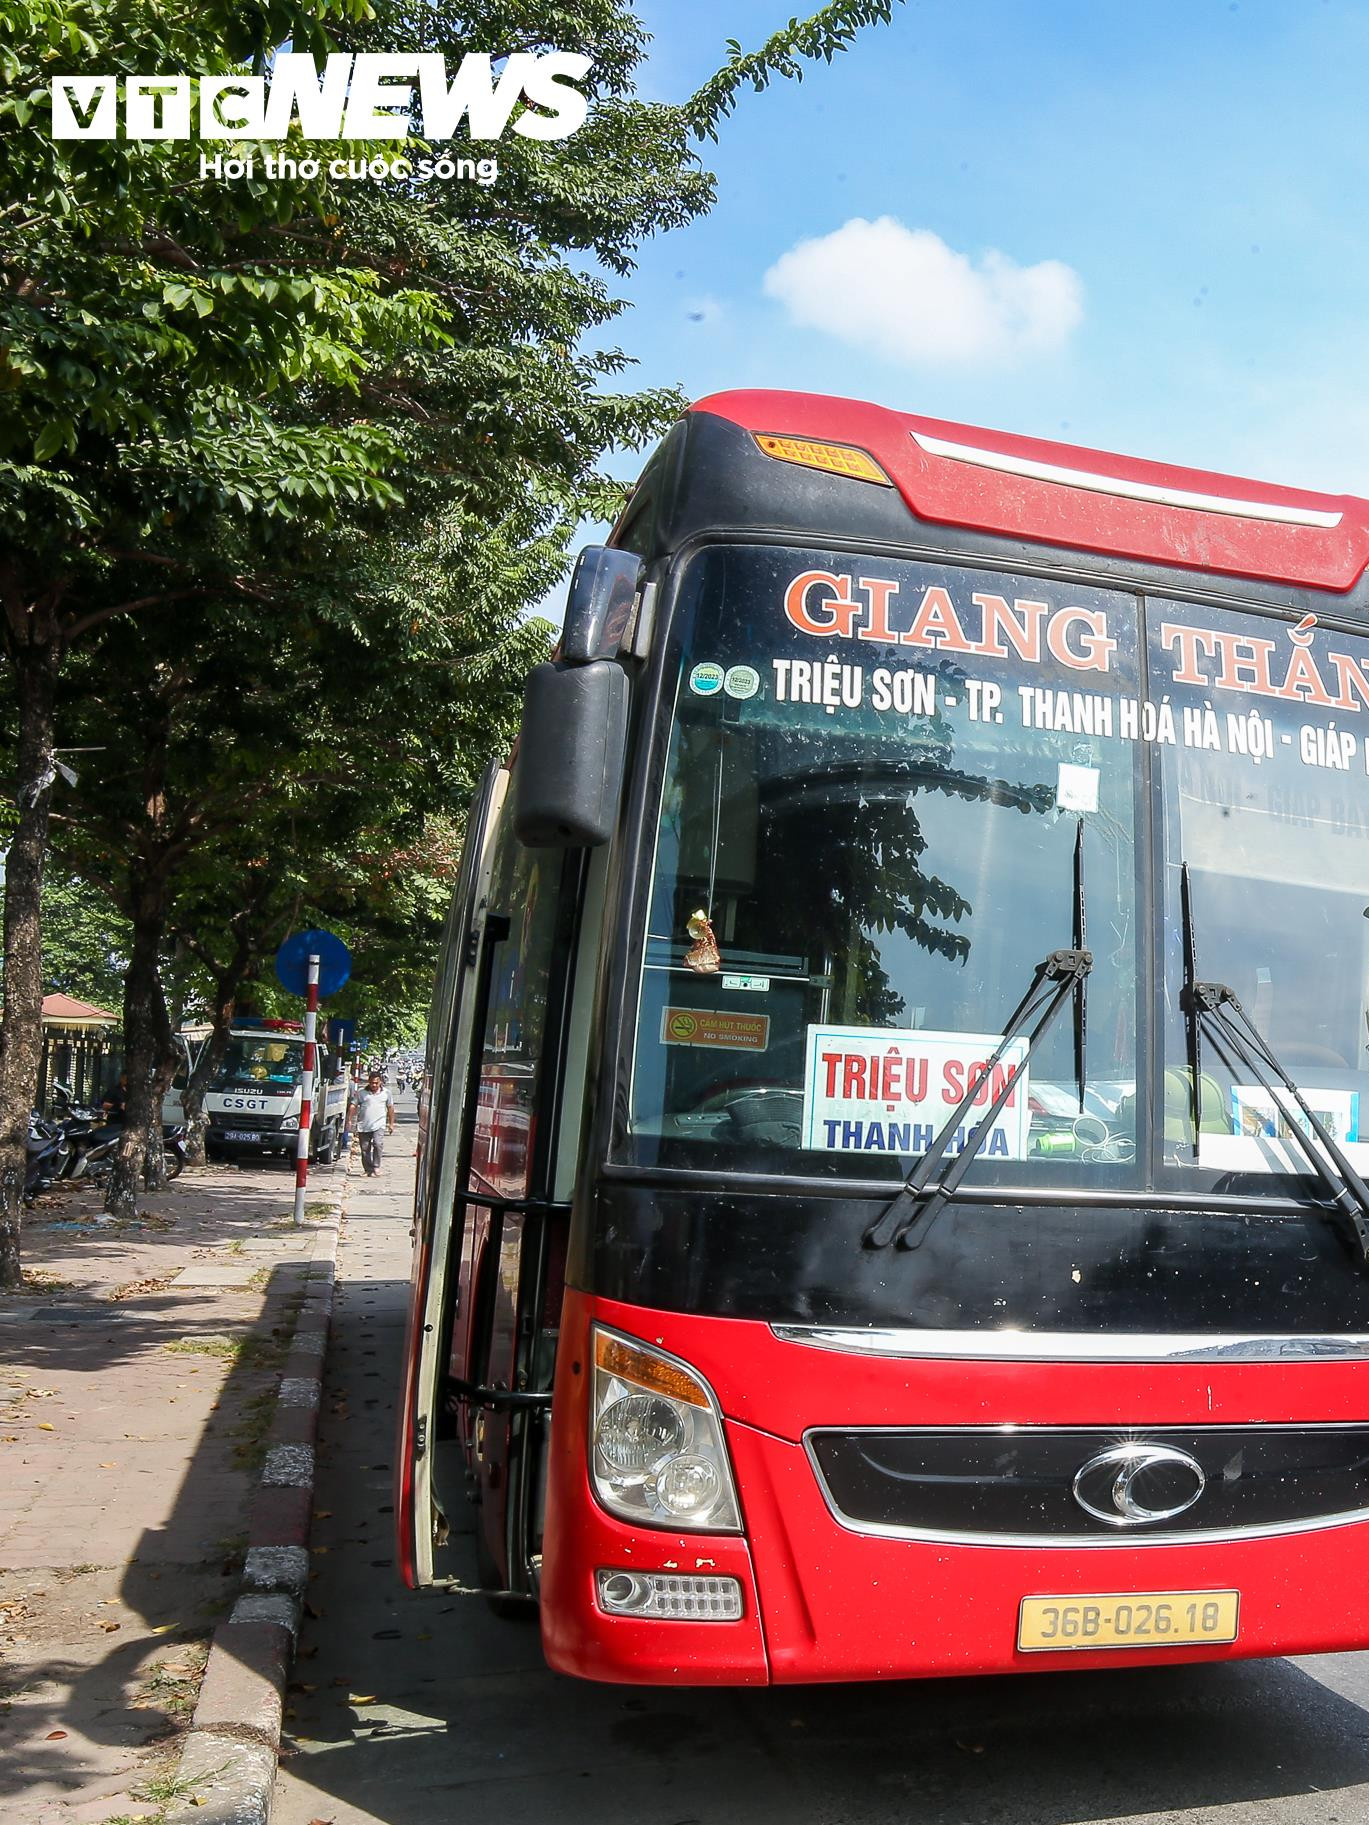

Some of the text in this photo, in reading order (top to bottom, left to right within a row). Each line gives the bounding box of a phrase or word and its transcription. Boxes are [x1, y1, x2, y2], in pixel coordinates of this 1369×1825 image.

[785, 570, 1117, 671] GIANG
[772, 655, 864, 714] TRIỆU
[871, 670, 937, 716] SƠN
[963, 679, 1004, 724] TP.
[1018, 686, 1112, 737] THANH
[1119, 695, 1176, 747] HOÁ
[1183, 700, 1221, 752] HÀ
[1227, 709, 1274, 766] NỘI
[1299, 721, 1358, 771] GIÁP
[703, 1032, 758, 1043] NO SMOKING
[822, 1047, 1018, 1112] TRIỆU SƠN
[224, 1098, 268, 1109] CSGT
[823, 1120, 936, 1153] THANH
[1040, 1602, 1220, 1638] 36B-026.18
